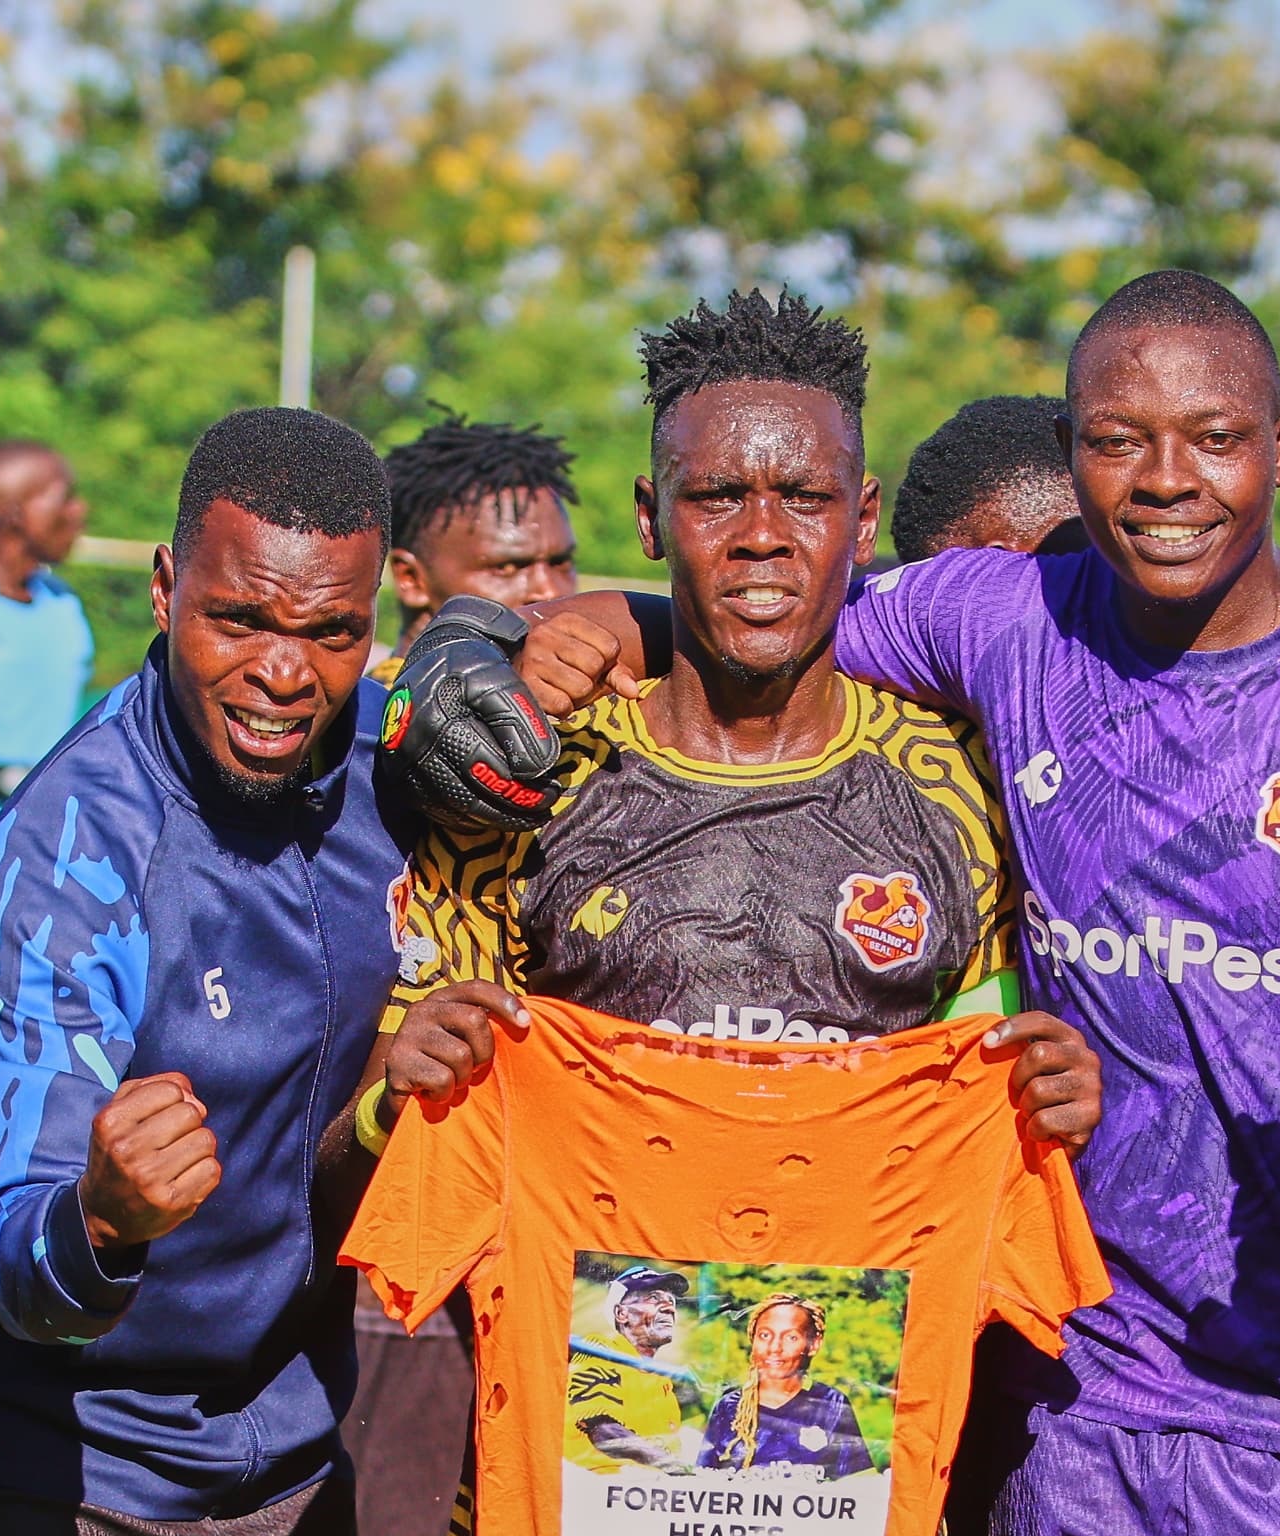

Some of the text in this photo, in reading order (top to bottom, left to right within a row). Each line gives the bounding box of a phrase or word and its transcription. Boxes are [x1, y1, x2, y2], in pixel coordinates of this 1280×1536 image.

[852, 923, 913, 954] MURANG'A
[869, 940, 892, 956] SEAL
[202, 966, 232, 1020] 5
[606, 1485, 856, 1520] FOREVER IN OUR
